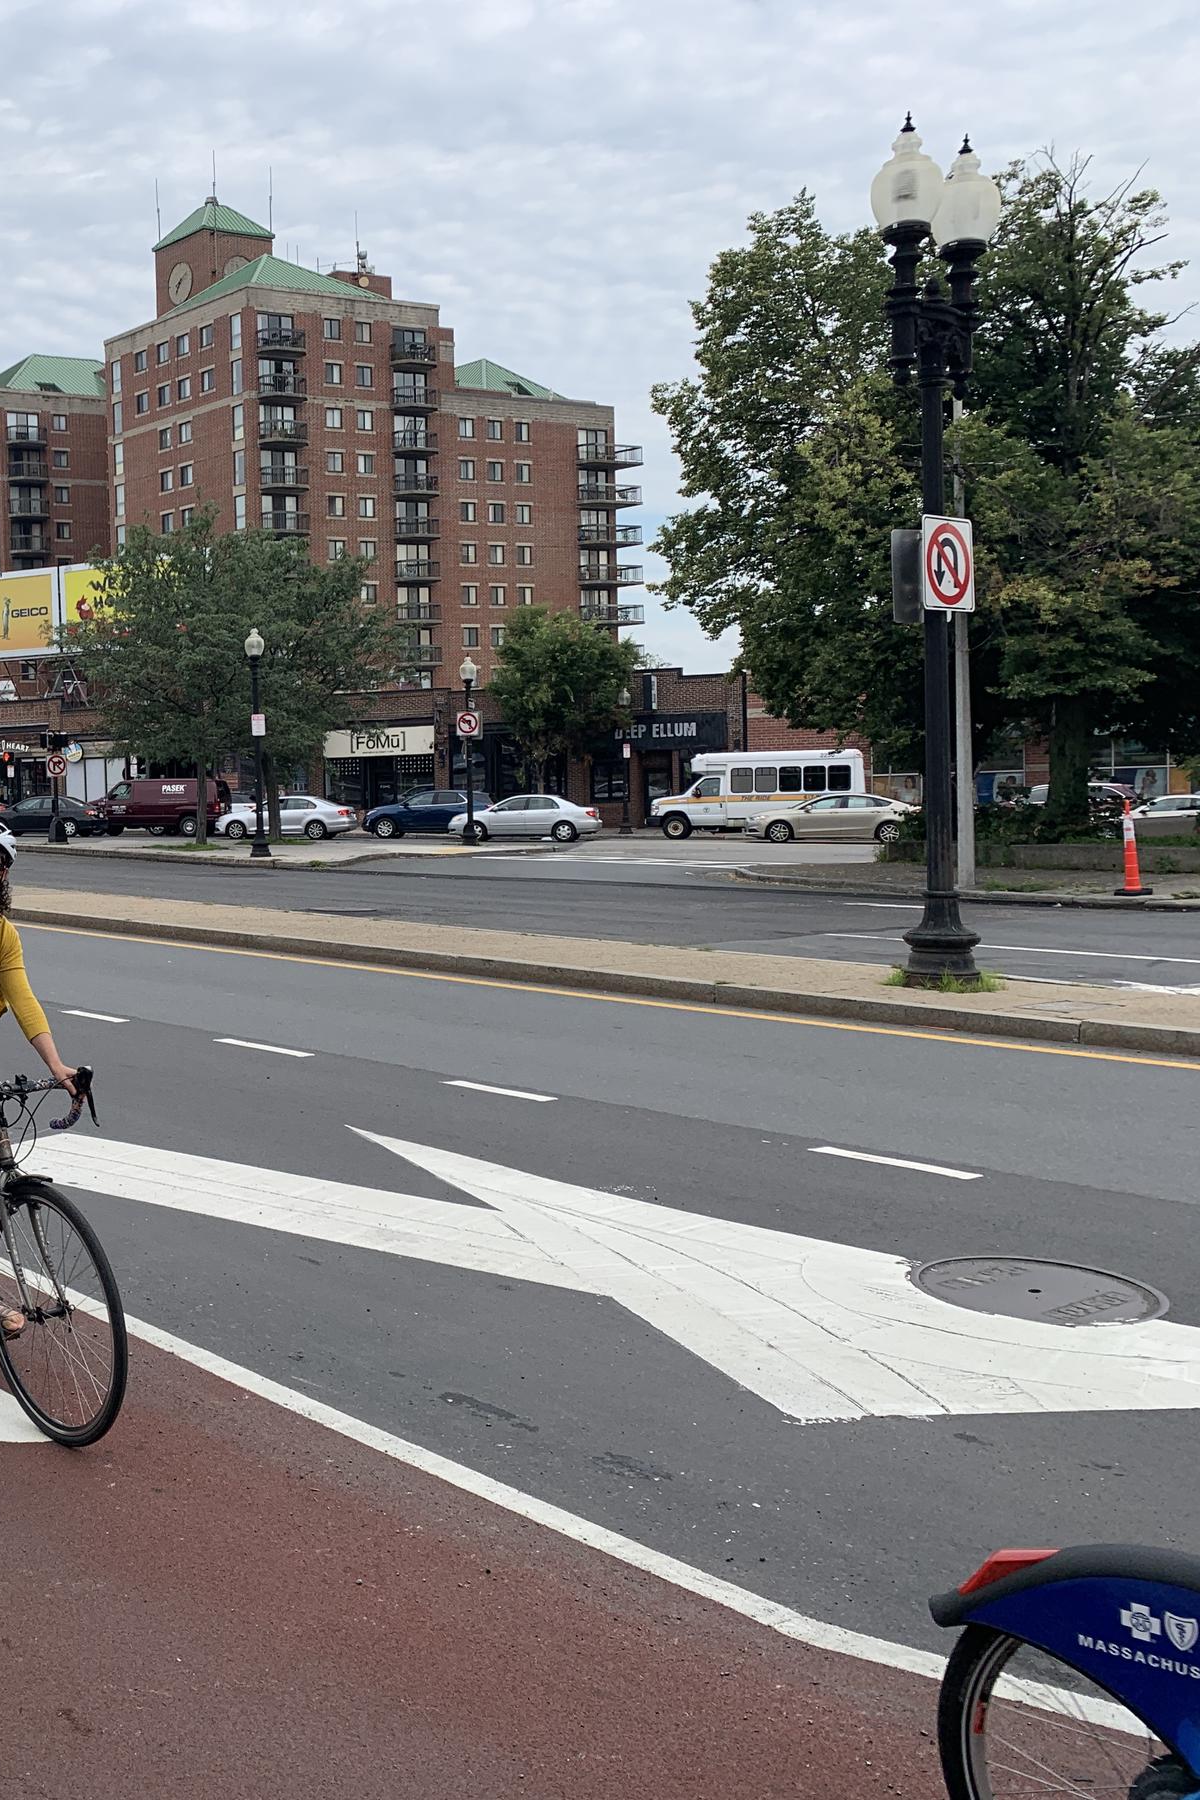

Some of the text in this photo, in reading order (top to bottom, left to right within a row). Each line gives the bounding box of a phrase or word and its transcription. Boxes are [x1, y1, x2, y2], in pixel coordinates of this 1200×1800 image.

[11, 607, 49, 618] GEICO
[652, 722, 697, 738] ELLUM
[6, 742, 30, 753] HEART
[161, 784, 185, 793] PASEK
